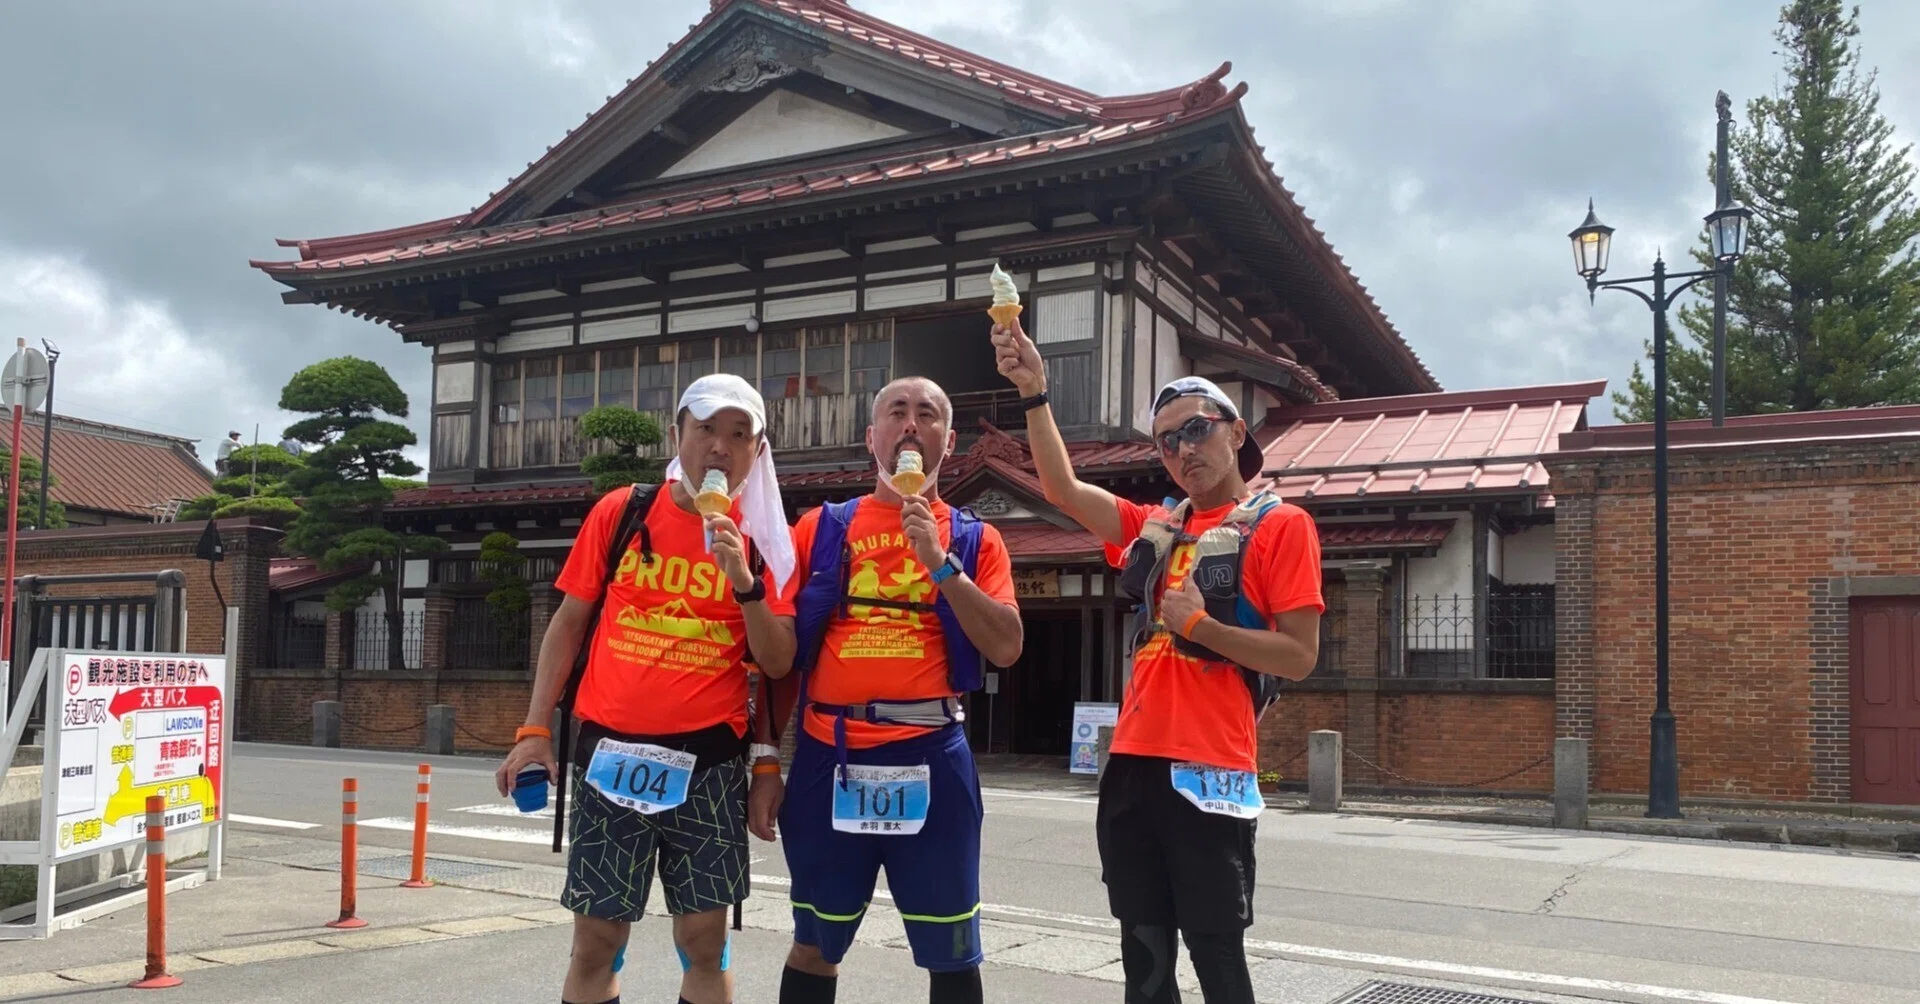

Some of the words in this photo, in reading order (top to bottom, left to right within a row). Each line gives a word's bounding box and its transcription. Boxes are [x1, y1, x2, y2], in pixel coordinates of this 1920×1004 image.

[88, 658, 208, 686] 観光施設ご利用の方へ
[64, 698, 107, 726] 大型バス
[141, 688, 188, 708] 大型バス
[612, 759, 669, 801] 104
[856, 785, 905, 817] 101
